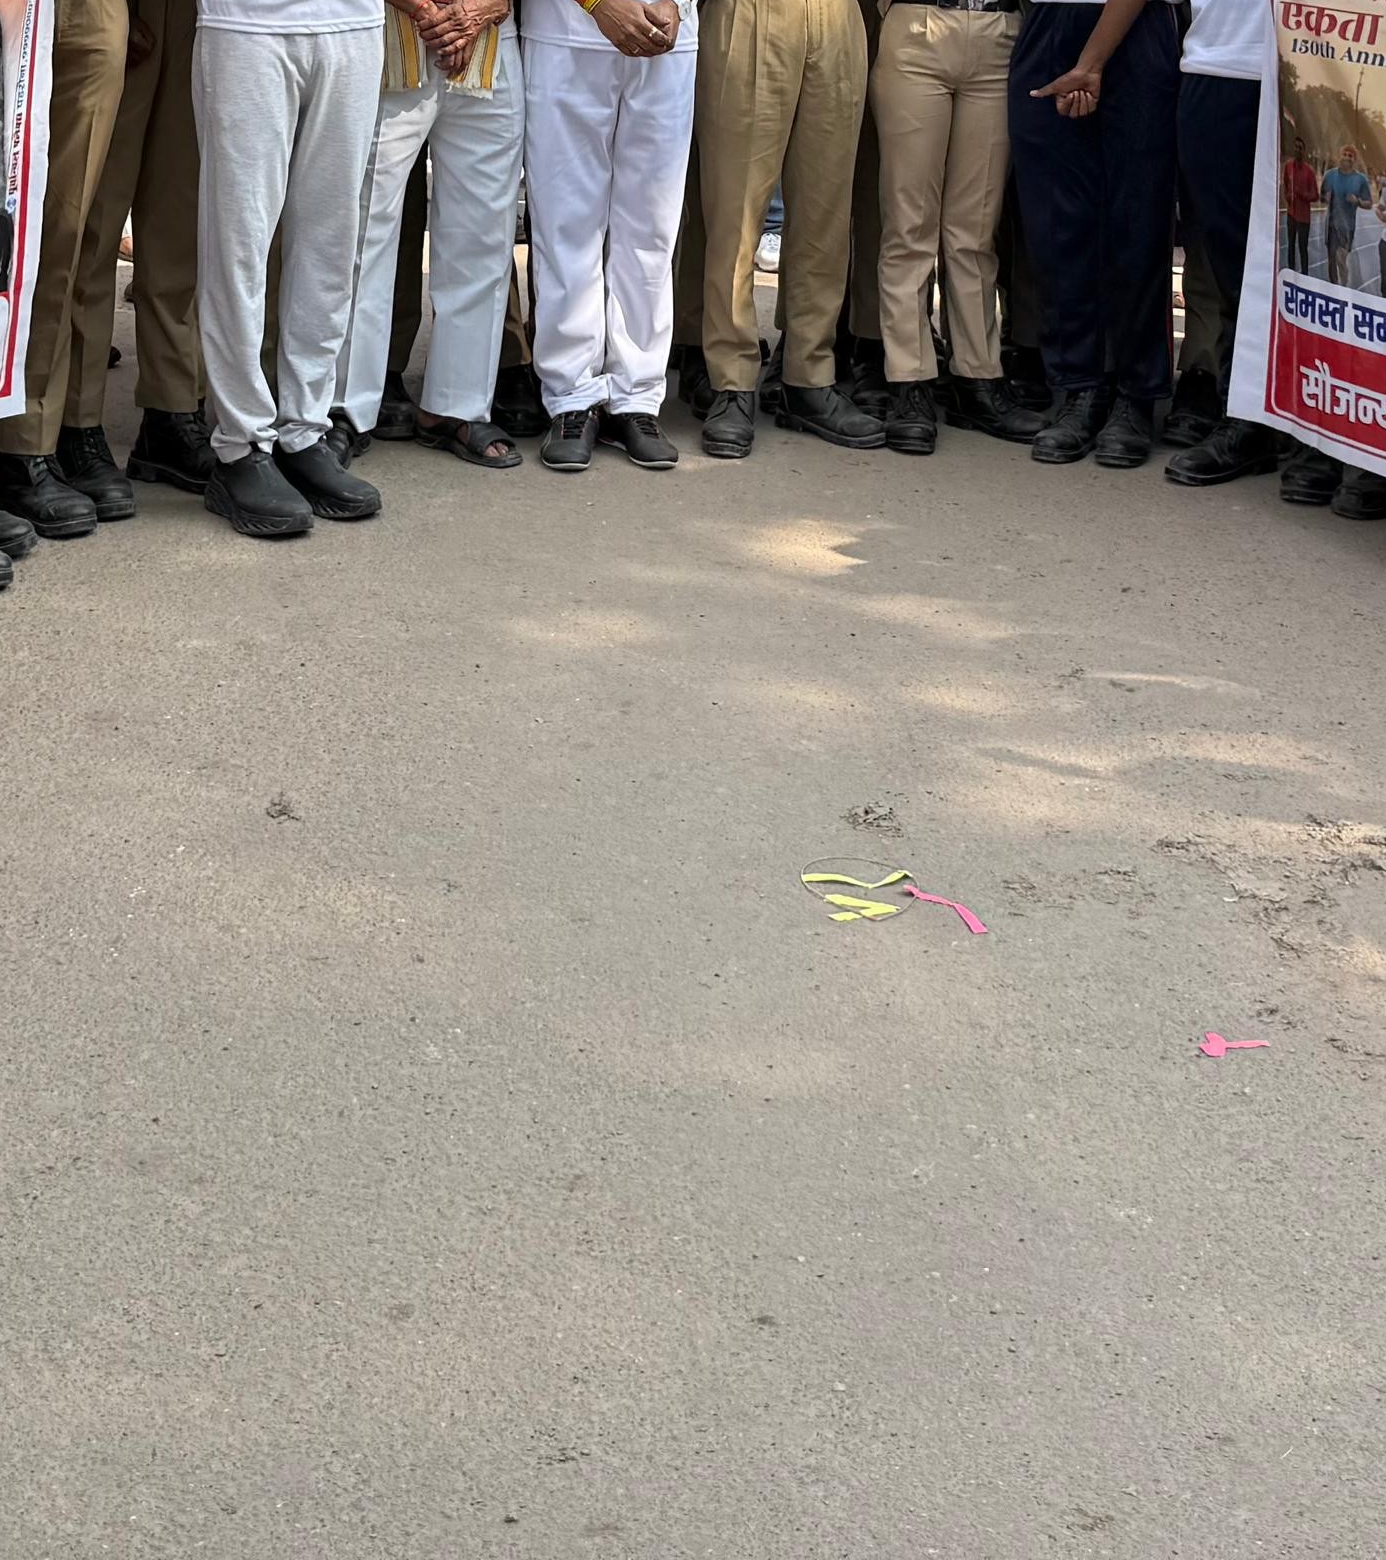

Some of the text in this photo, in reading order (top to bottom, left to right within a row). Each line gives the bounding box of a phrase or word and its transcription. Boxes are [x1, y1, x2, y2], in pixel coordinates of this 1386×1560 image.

[1279, 0, 1385, 47] एकता
[1290, 37, 1337, 61] 150th
[1281, 278, 1349, 335] समस्त
